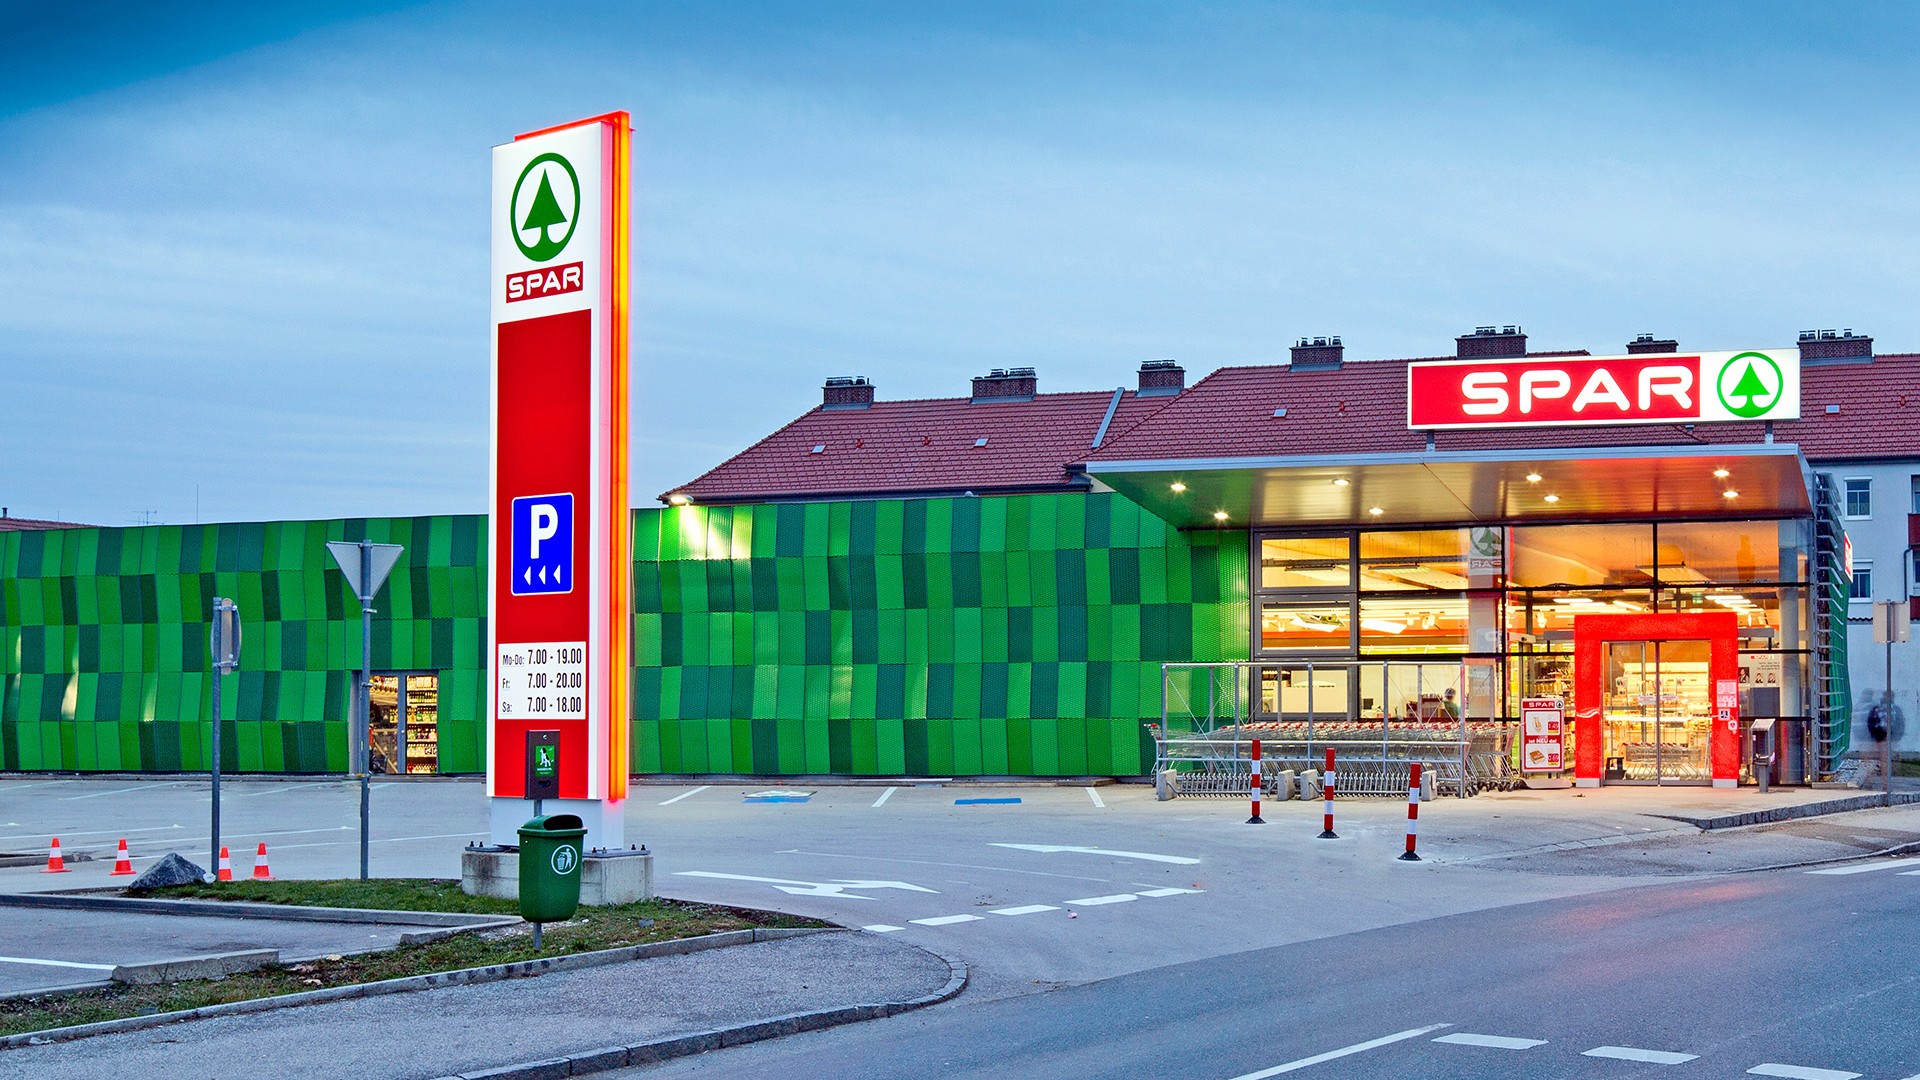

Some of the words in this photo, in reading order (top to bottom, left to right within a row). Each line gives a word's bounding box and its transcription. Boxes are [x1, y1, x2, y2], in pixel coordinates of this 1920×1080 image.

[508, 265, 581, 299] SPAR
[1461, 365, 1694, 416] SPAR
[530, 503, 559, 560] P
[502, 654, 525, 666] Mo-Do:
[527, 648, 547, 665] 7.00
[556, 648, 582, 664] 19.00
[502, 678, 511, 689] Fr:
[527, 672, 547, 688] 7.00
[556, 672, 582, 688] 20.00
[502, 701, 513, 713] Sa:
[527, 696, 547, 712] 7.00
[556, 696, 582, 712] 18.00
